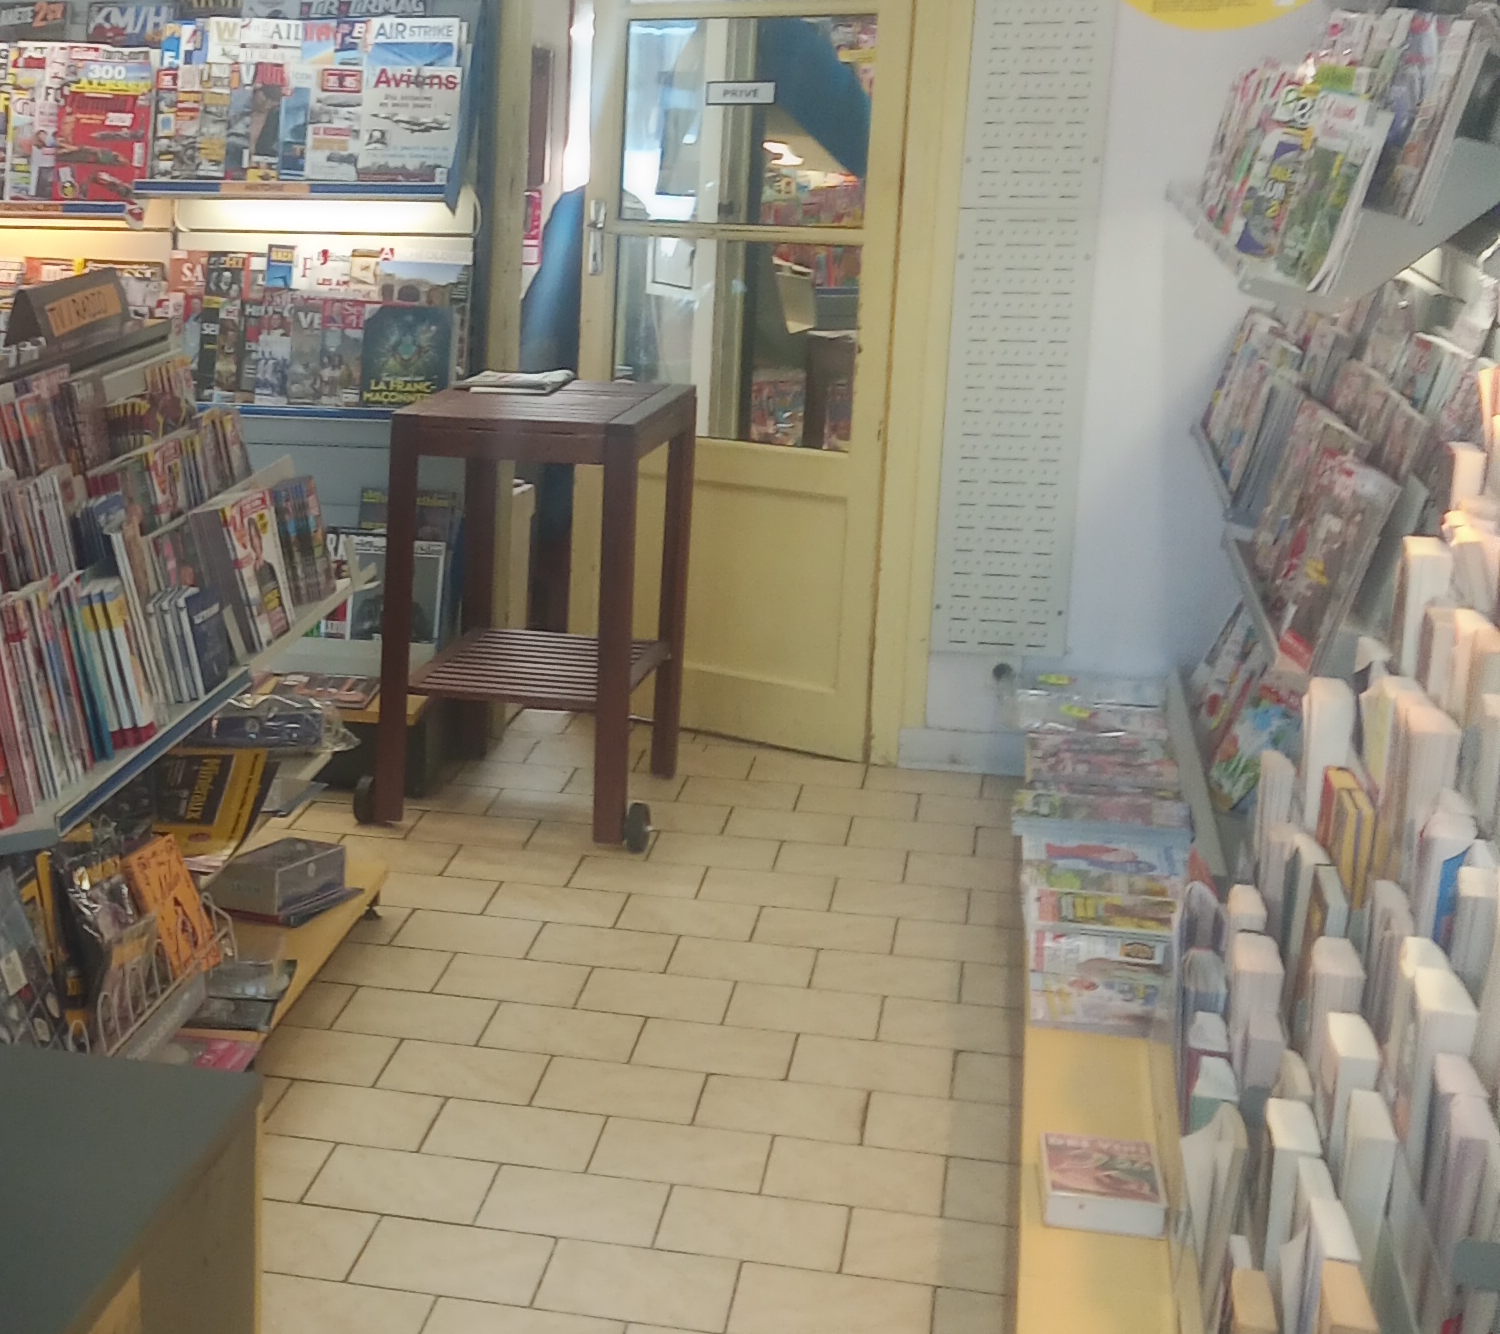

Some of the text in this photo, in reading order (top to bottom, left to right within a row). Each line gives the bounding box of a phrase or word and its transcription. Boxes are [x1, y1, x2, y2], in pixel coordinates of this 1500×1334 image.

[375, 22, 455, 40] AIR STRIKE
[88, 66, 127, 80] 300
[374, 68, 459, 91] Avions
